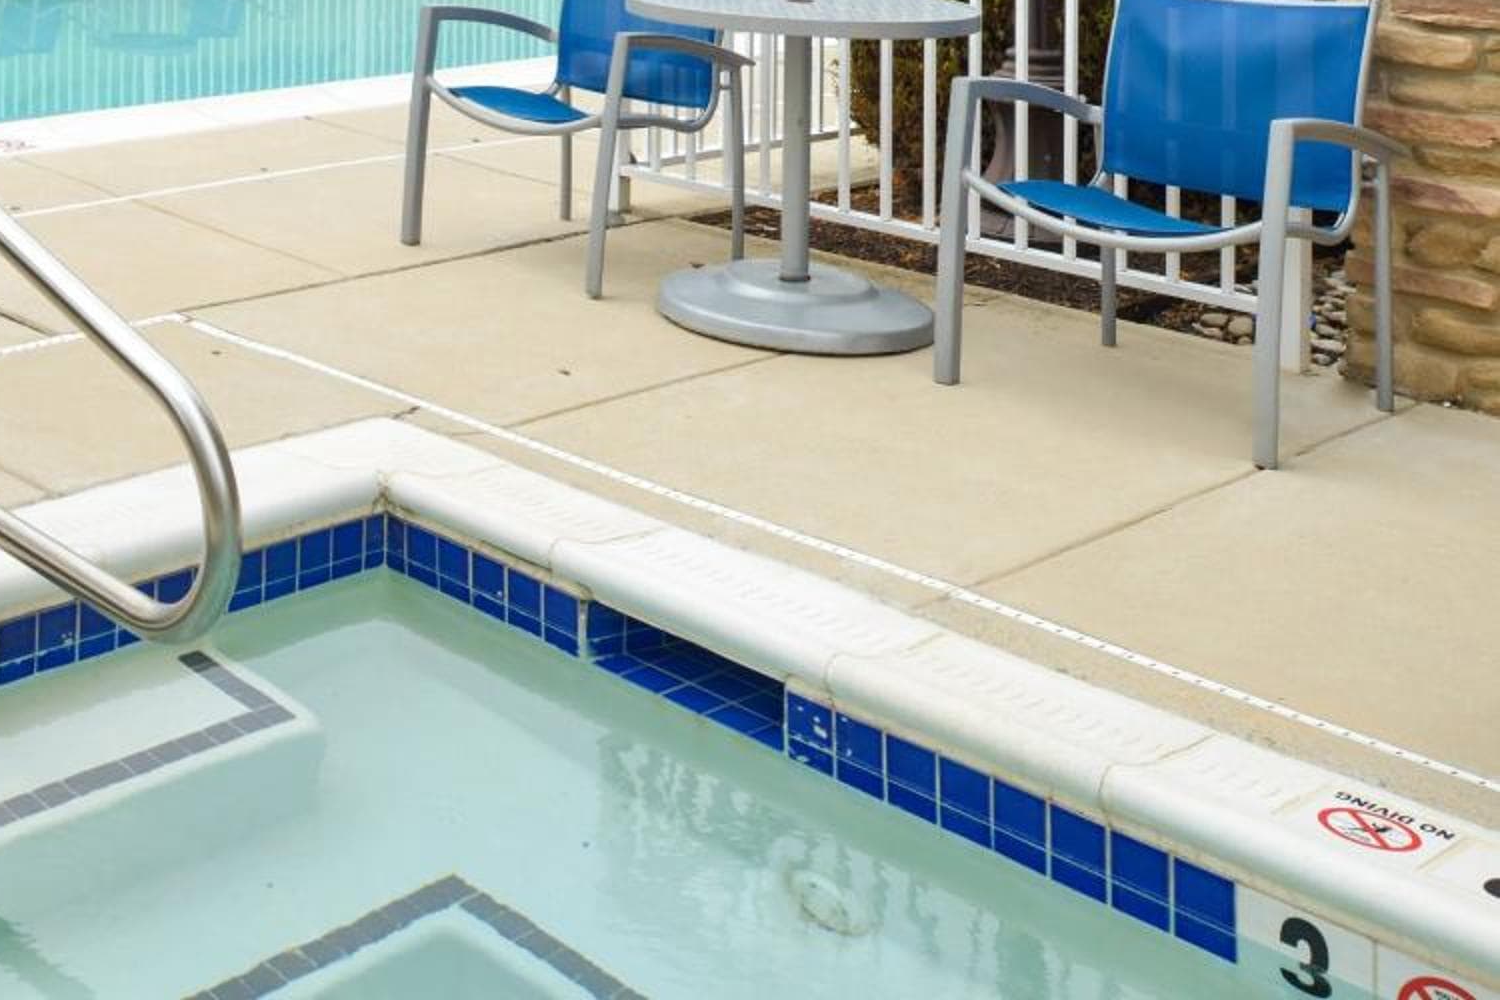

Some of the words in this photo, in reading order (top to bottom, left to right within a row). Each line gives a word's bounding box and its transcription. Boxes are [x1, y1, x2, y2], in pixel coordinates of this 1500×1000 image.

[1334, 791, 1415, 825] DIVING
[1419, 823, 1455, 840] NO
[1279, 917, 1333, 998] 3
